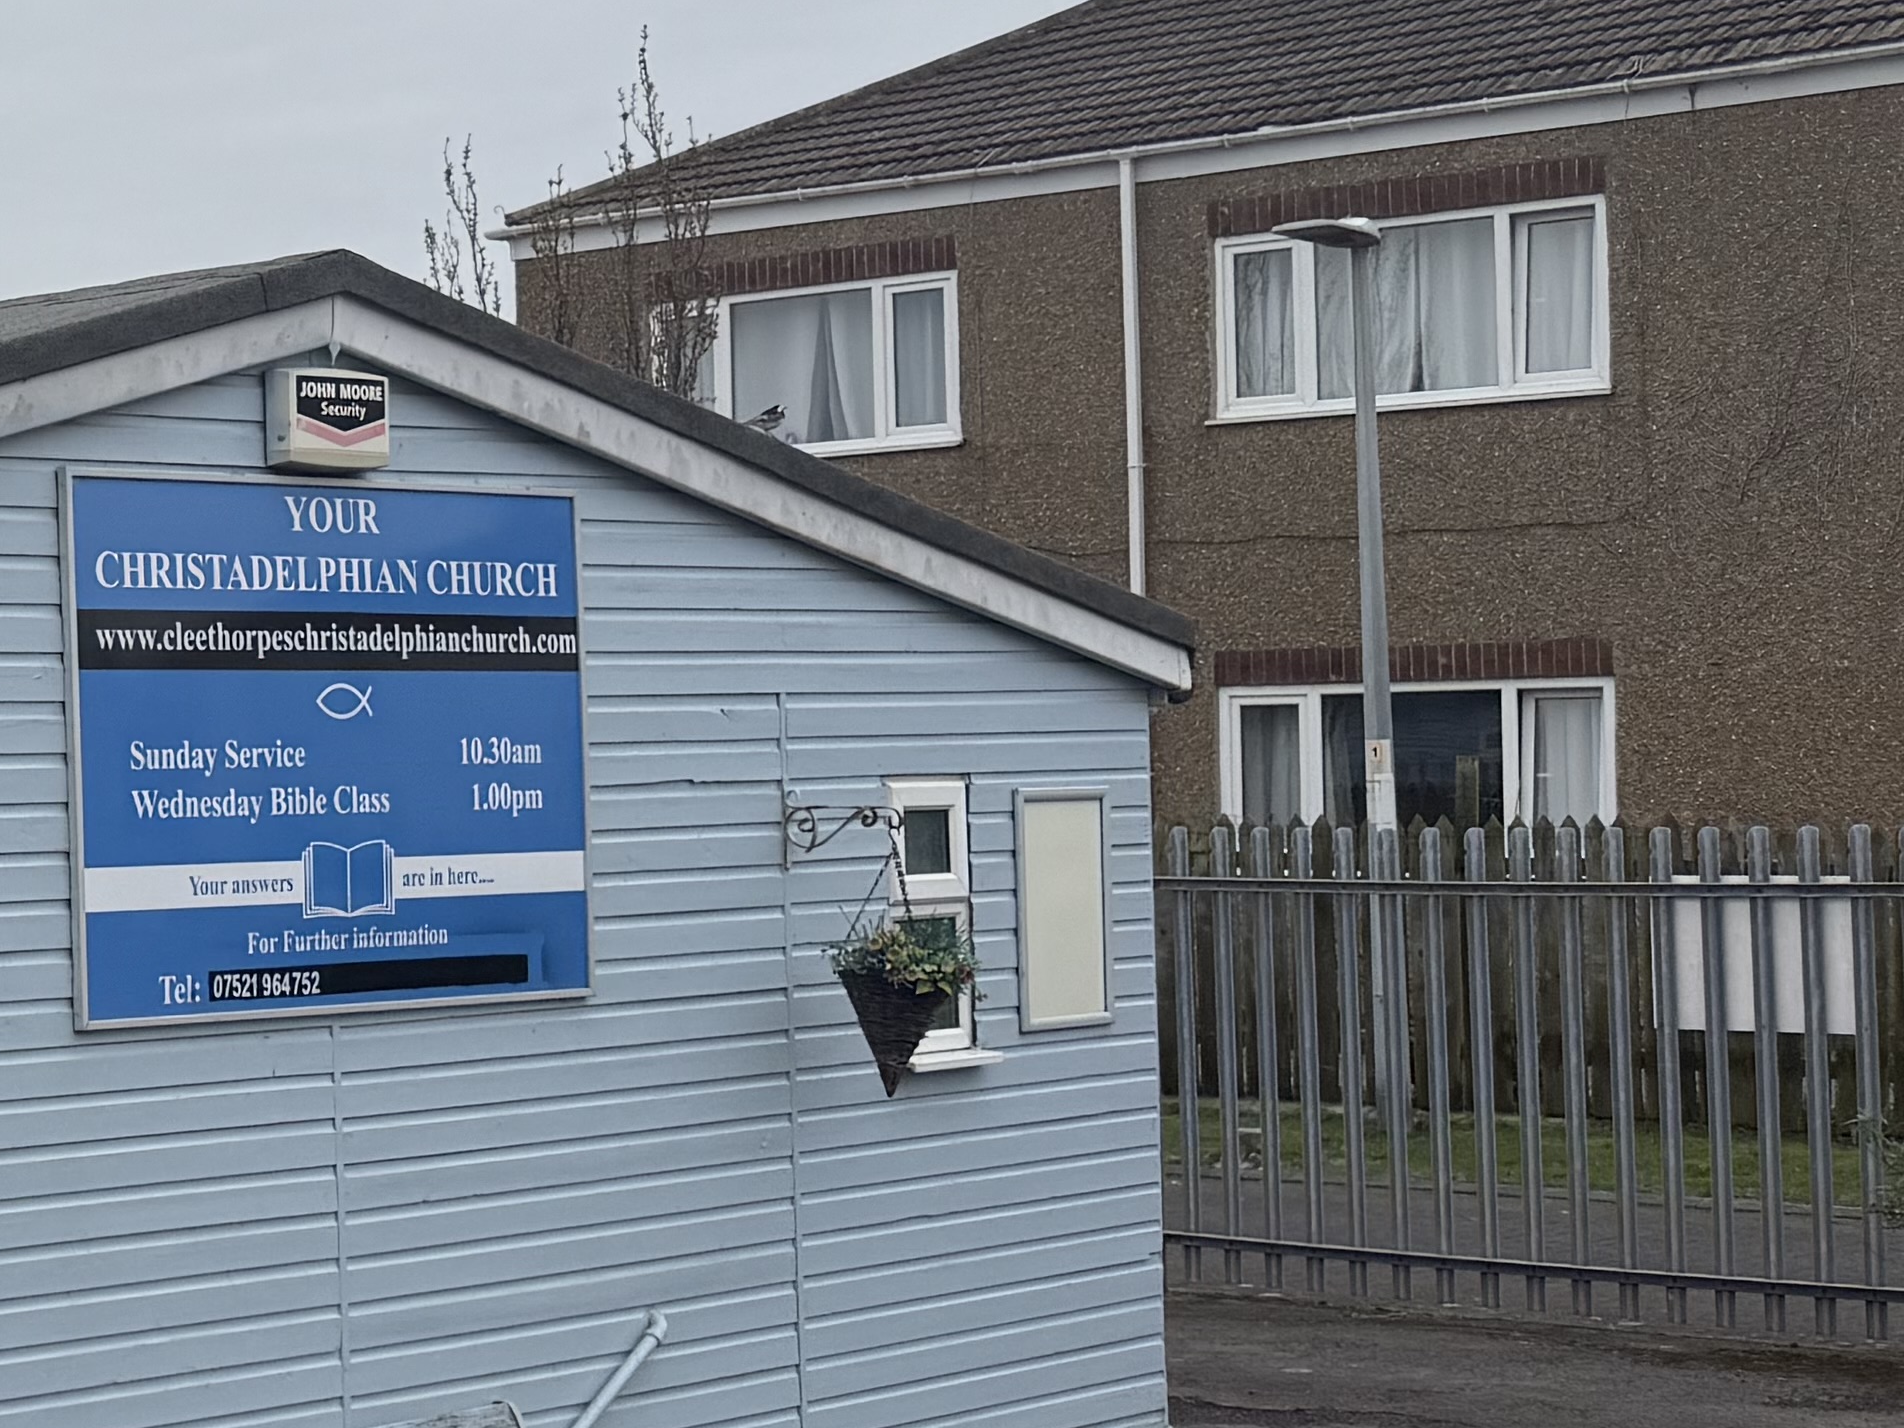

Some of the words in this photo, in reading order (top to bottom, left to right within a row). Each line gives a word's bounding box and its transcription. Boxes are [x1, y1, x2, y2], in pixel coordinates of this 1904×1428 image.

[299, 381, 336, 399] JOHN
[339, 383, 383, 401] MOORE
[320, 401, 366, 421] Security
[284, 496, 380, 535] YOUR
[95, 550, 419, 596] CHRISTADELPHIAN
[427, 560, 558, 598] CHURCH
[96, 622, 577, 660] www.cleethorpeschristadelphianchurch.com
[130, 740, 218, 777] Sunday
[224, 739, 306, 770] Service
[459, 737, 542, 765] 10.30am
[131, 788, 263, 824] Wednesday
[269, 786, 327, 816] Bible
[333, 785, 391, 815] Class
[472, 783, 543, 817] 1.00pm
[189, 875, 228, 896] Your
[232, 877, 293, 895] answers
[402, 872, 425, 887] are
[430, 868, 443, 886] in
[247, 932, 279, 955] For
[283, 927, 349, 953] Further
[353, 923, 448, 949] information
[158, 974, 201, 1005] Tel:
[213, 973, 258, 999] 07521
